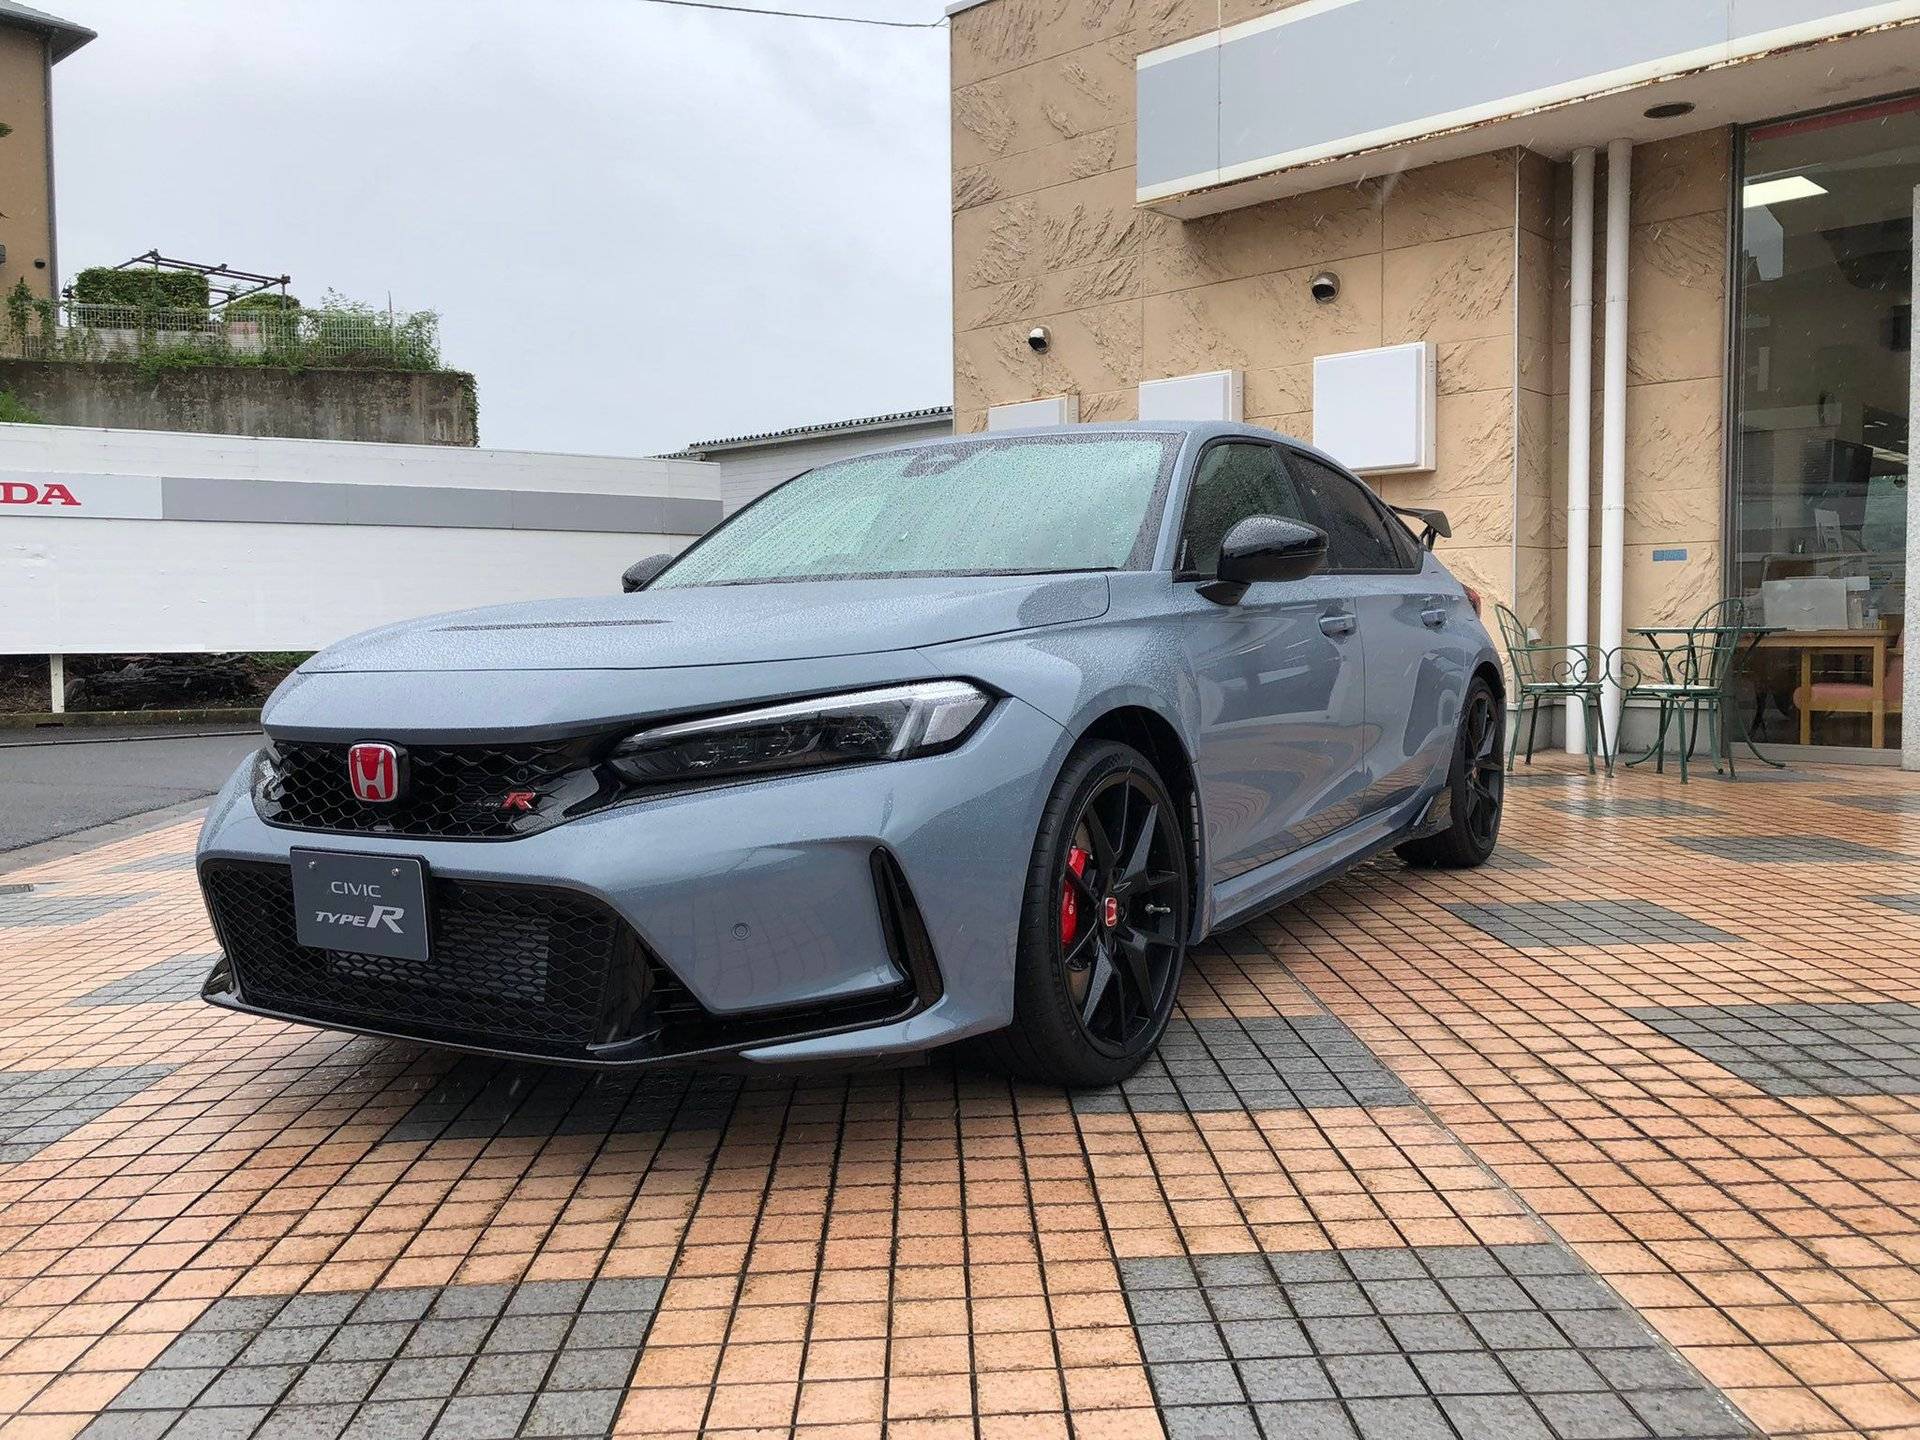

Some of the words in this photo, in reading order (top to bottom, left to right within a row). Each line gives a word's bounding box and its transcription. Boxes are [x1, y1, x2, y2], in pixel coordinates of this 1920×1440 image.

[331, 881, 382, 898] CIVIC
[315, 911, 367, 927] TYPE
[366, 904, 405, 934] R
